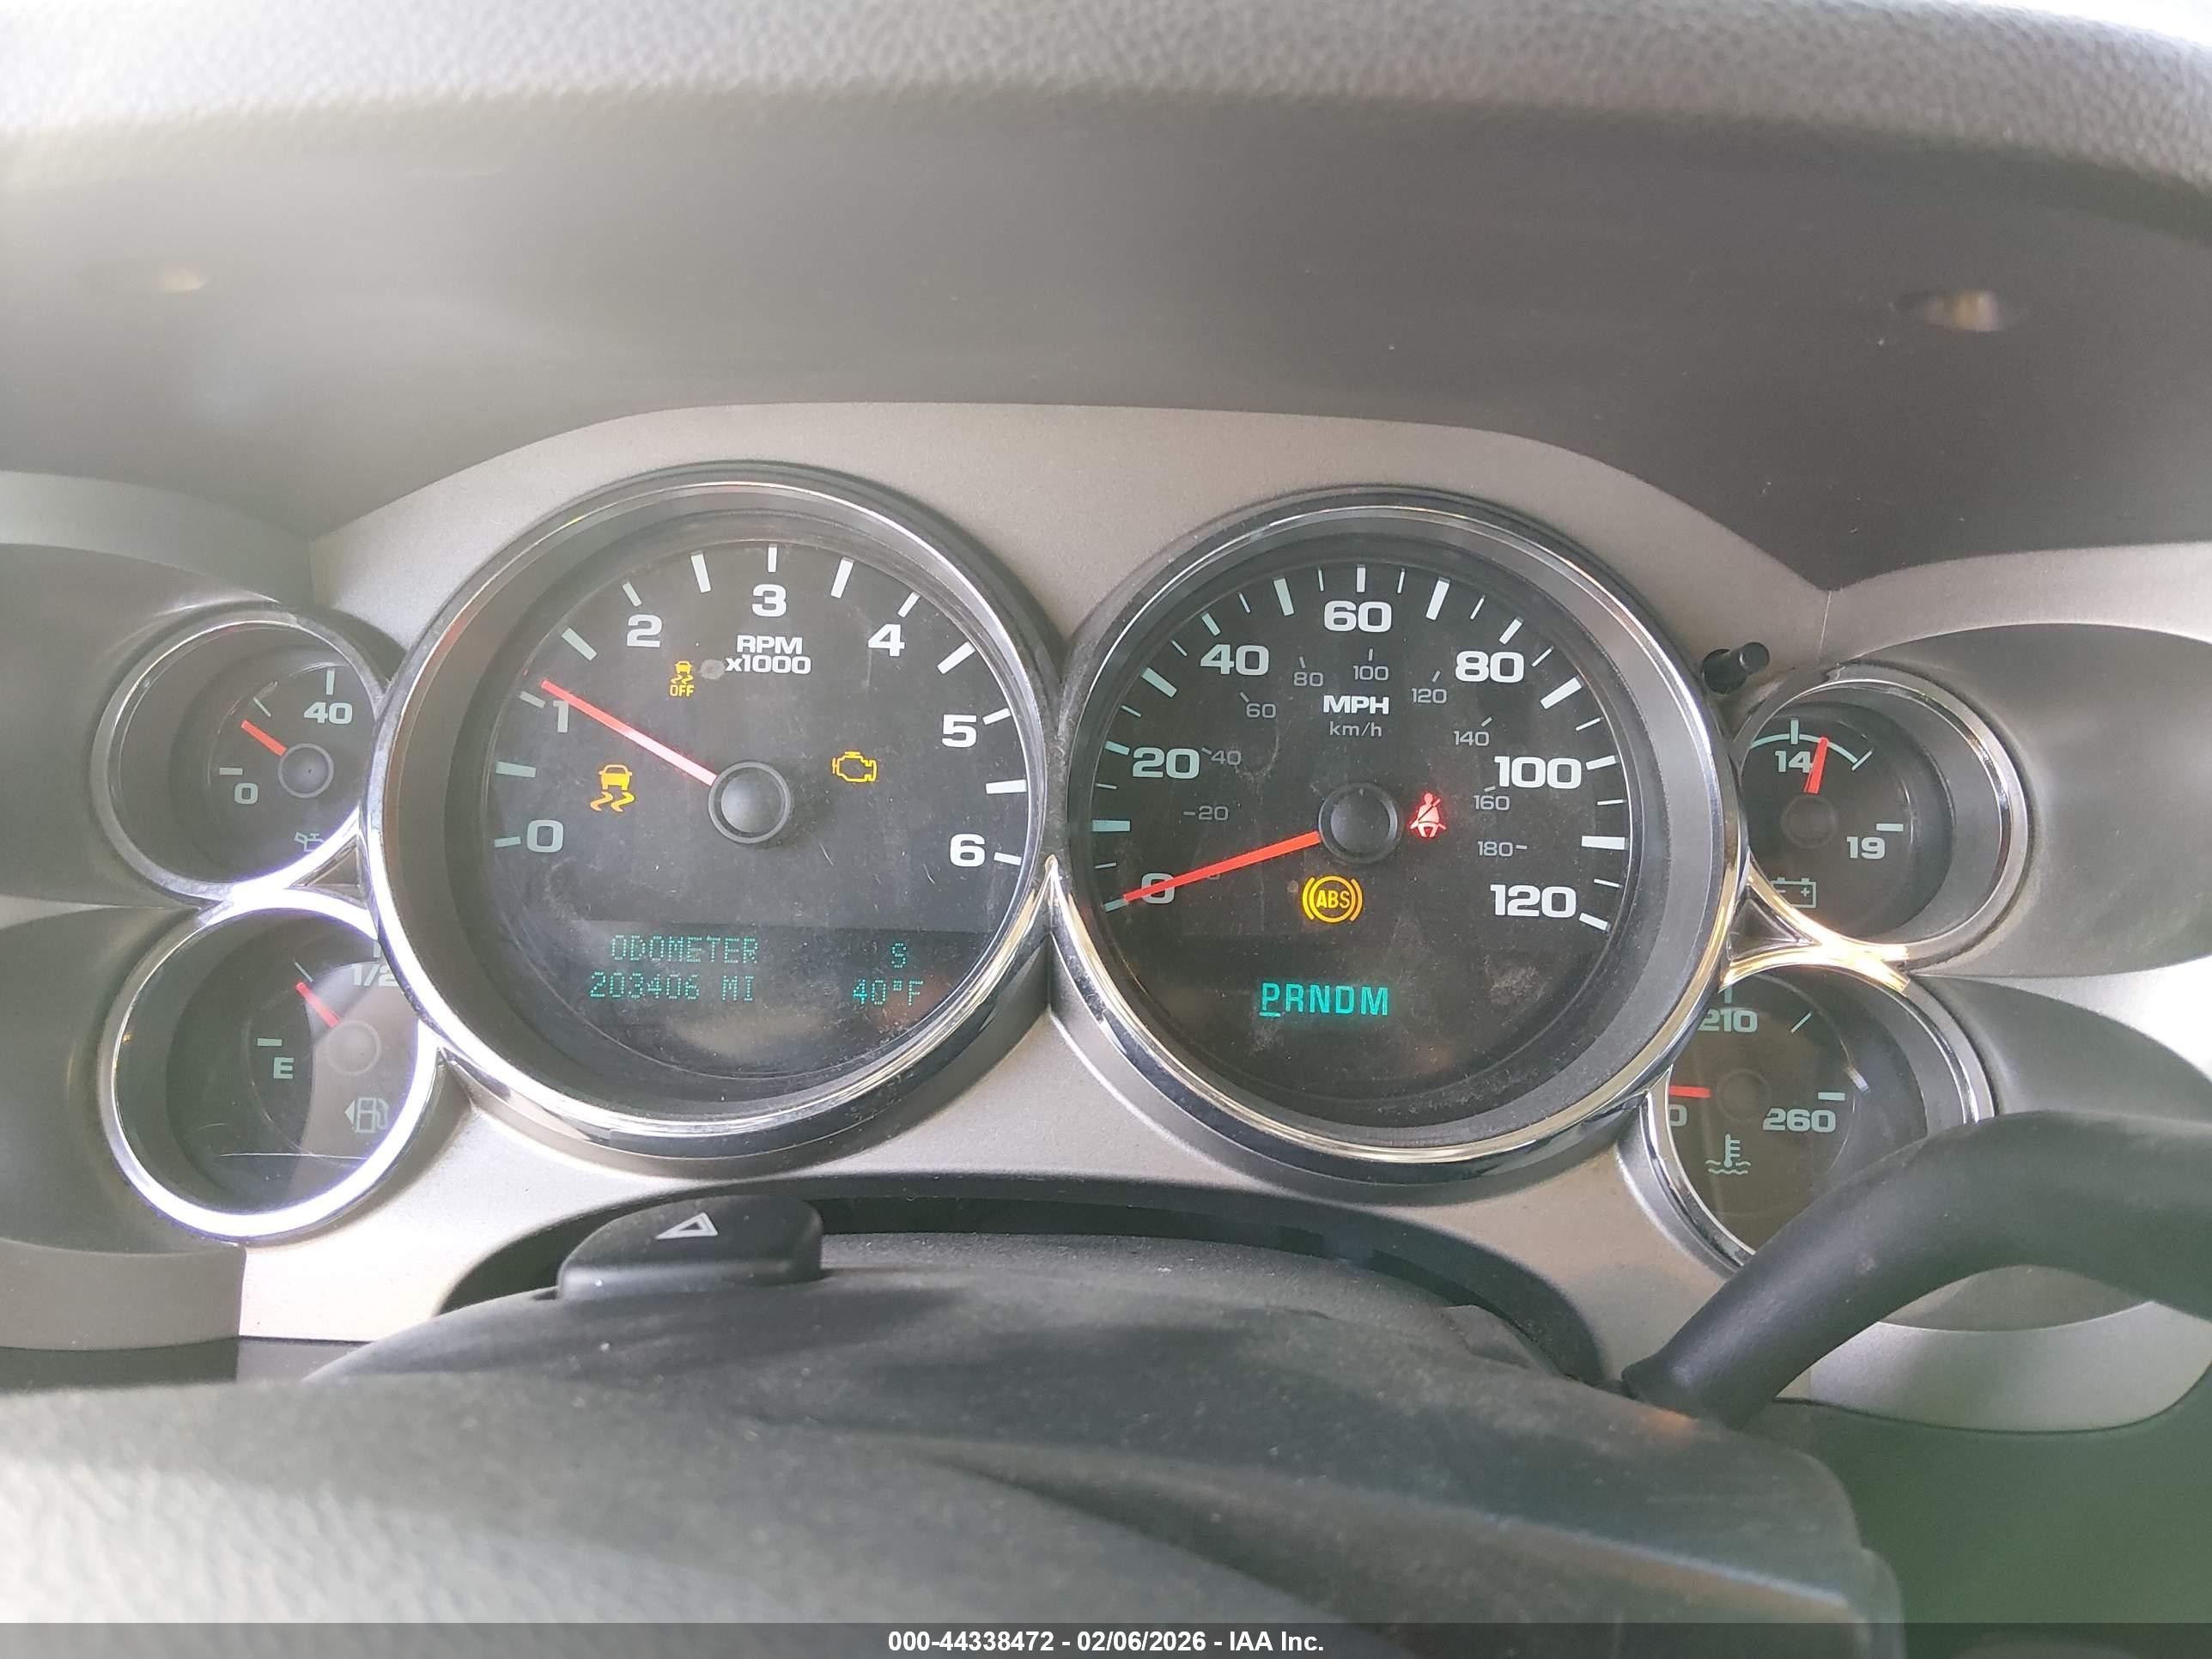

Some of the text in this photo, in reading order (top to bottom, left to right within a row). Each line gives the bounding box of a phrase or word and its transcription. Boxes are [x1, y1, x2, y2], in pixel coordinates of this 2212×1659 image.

[751, 584, 787, 617] 3
[1323, 600, 1392, 634] 60
[626, 614, 663, 647] 2
[867, 623, 905, 657] 4
[737, 635, 803, 653] RPM
[725, 655, 811, 675] x1000
[1200, 643, 1269, 676] 40
[1455, 651, 1524, 683] 80
[1293, 672, 1323, 687] 80
[1352, 665, 1389, 681] 100
[669, 684, 694, 697] OFF
[1411, 688, 1447, 704] 120
[303, 702, 353, 725] 40
[553, 700, 569, 733] 1
[1245, 703, 1277, 719] 60
[1322, 695, 1389, 715] MPH
[942, 714, 977, 749] 5
[1329, 721, 1382, 738] km/h
[1454, 731, 1490, 746] 140
[1133, 747, 1200, 779] 20
[1211, 750, 1242, 765] 40
[1775, 750, 1813, 773] 14
[1494, 756, 1582, 789] 100
[234, 782, 258, 805] 0
[1474, 795, 1510, 811] 160
[1198, 805, 1229, 820] 20
[527, 820, 564, 853] 0
[1477, 841, 1513, 857] 180
[1846, 836, 1886, 860] 19
[950, 833, 986, 867] 6
[1141, 872, 1176, 904] 0
[1316, 890, 1351, 908] ABS
[1491, 884, 1577, 918] 120
[611, 934, 759, 964] ODOMETER
[891, 943, 907, 969] S
[590, 970, 700, 1000] 203406
[721, 975, 755, 1001] MI
[852, 979, 925, 1006] 40°F
[1259, 982, 1389, 1017] PRNDM
[1698, 1006, 1758, 1033] 210
[273, 1057, 294, 1079] E
[1763, 1109, 1836, 1133] 260
